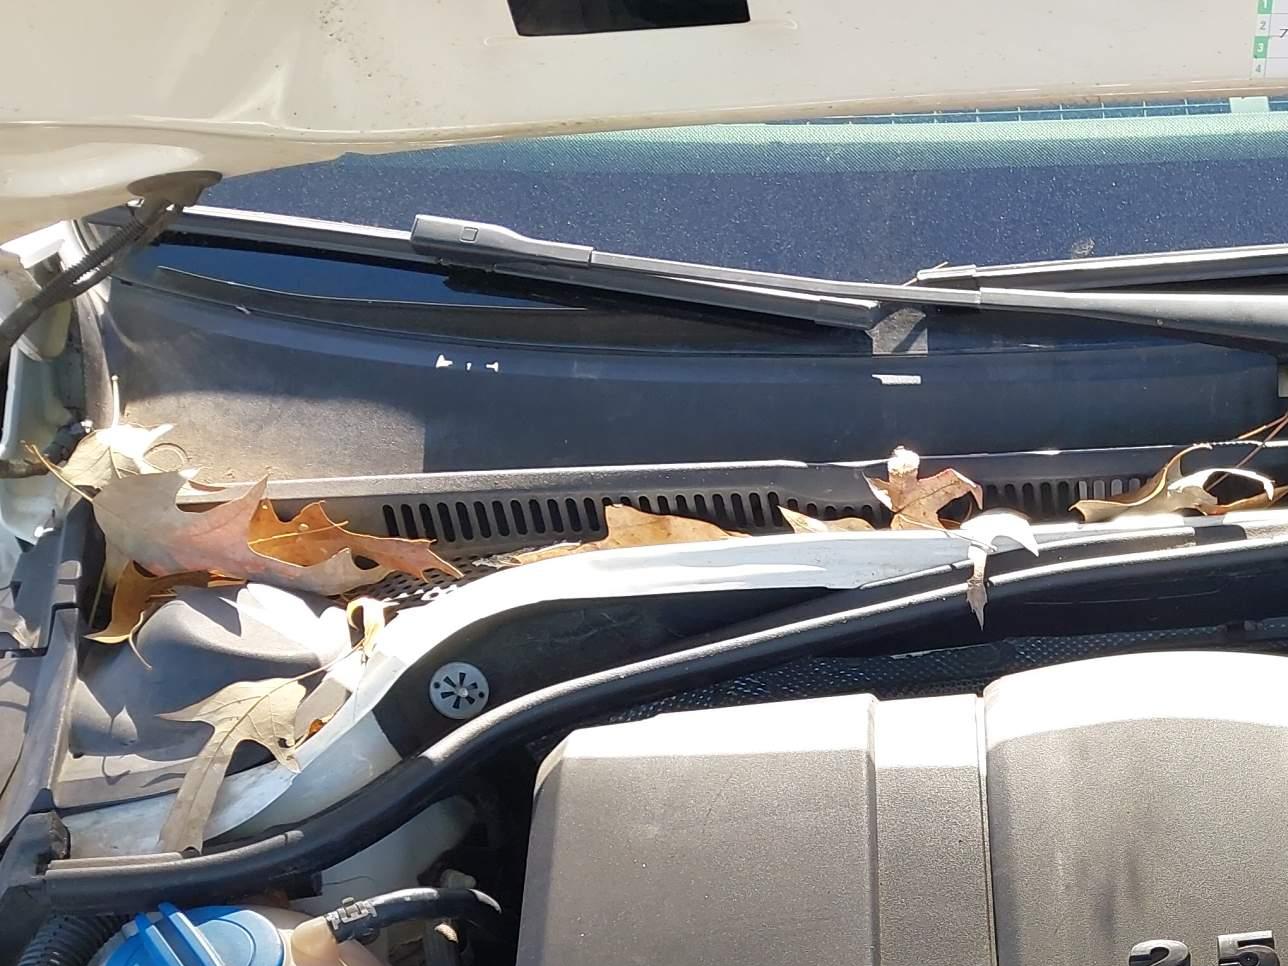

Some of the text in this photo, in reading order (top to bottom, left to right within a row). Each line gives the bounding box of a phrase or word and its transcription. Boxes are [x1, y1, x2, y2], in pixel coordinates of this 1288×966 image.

[1259, 20, 1267, 31] 2
[1256, 42, 1264, 53] 3
[1255, 63, 1262, 74] 4
